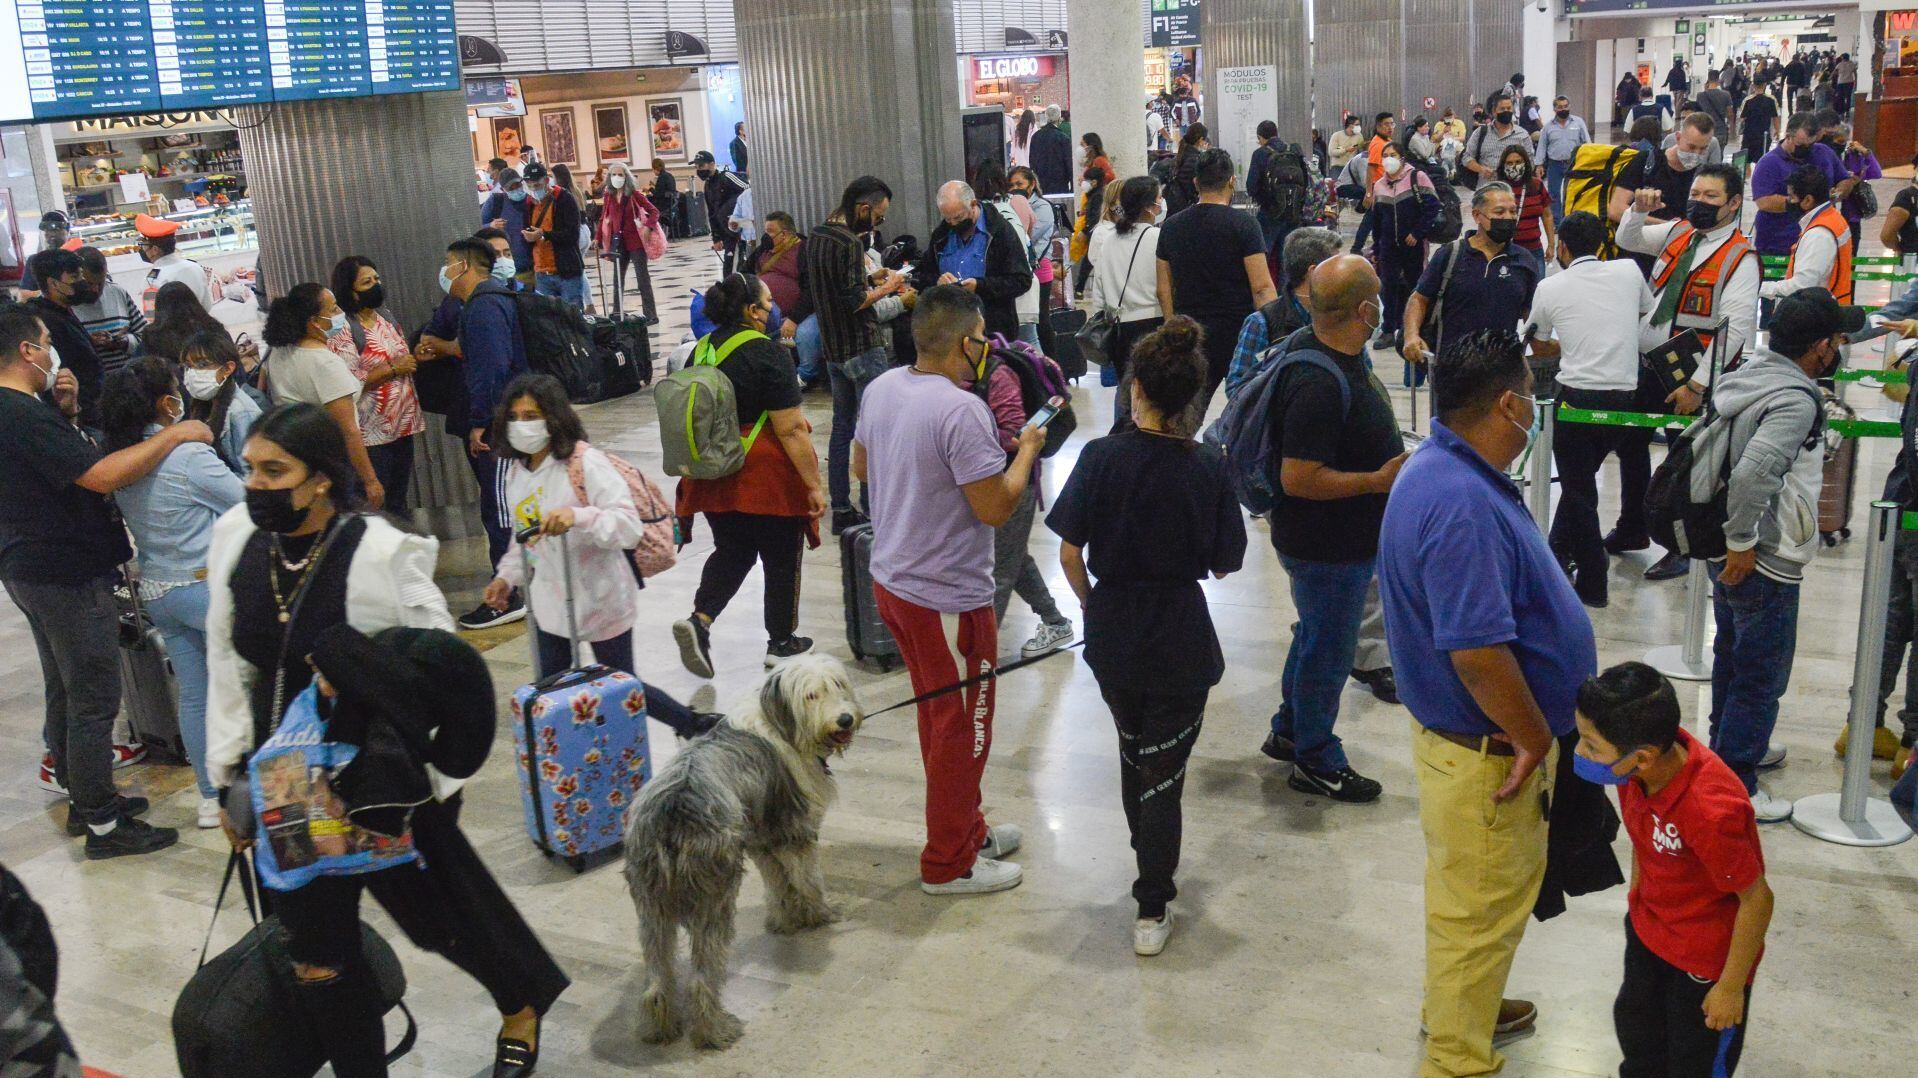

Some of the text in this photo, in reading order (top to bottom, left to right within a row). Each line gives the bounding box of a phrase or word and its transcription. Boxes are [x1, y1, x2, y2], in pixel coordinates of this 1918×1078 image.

[1153, 16, 1169, 32] F1
[980, 58, 1038, 78] EL GLOBO
[1225, 83, 1267, 93] COVID-19
[973, 707, 988, 758] BLANCAS
